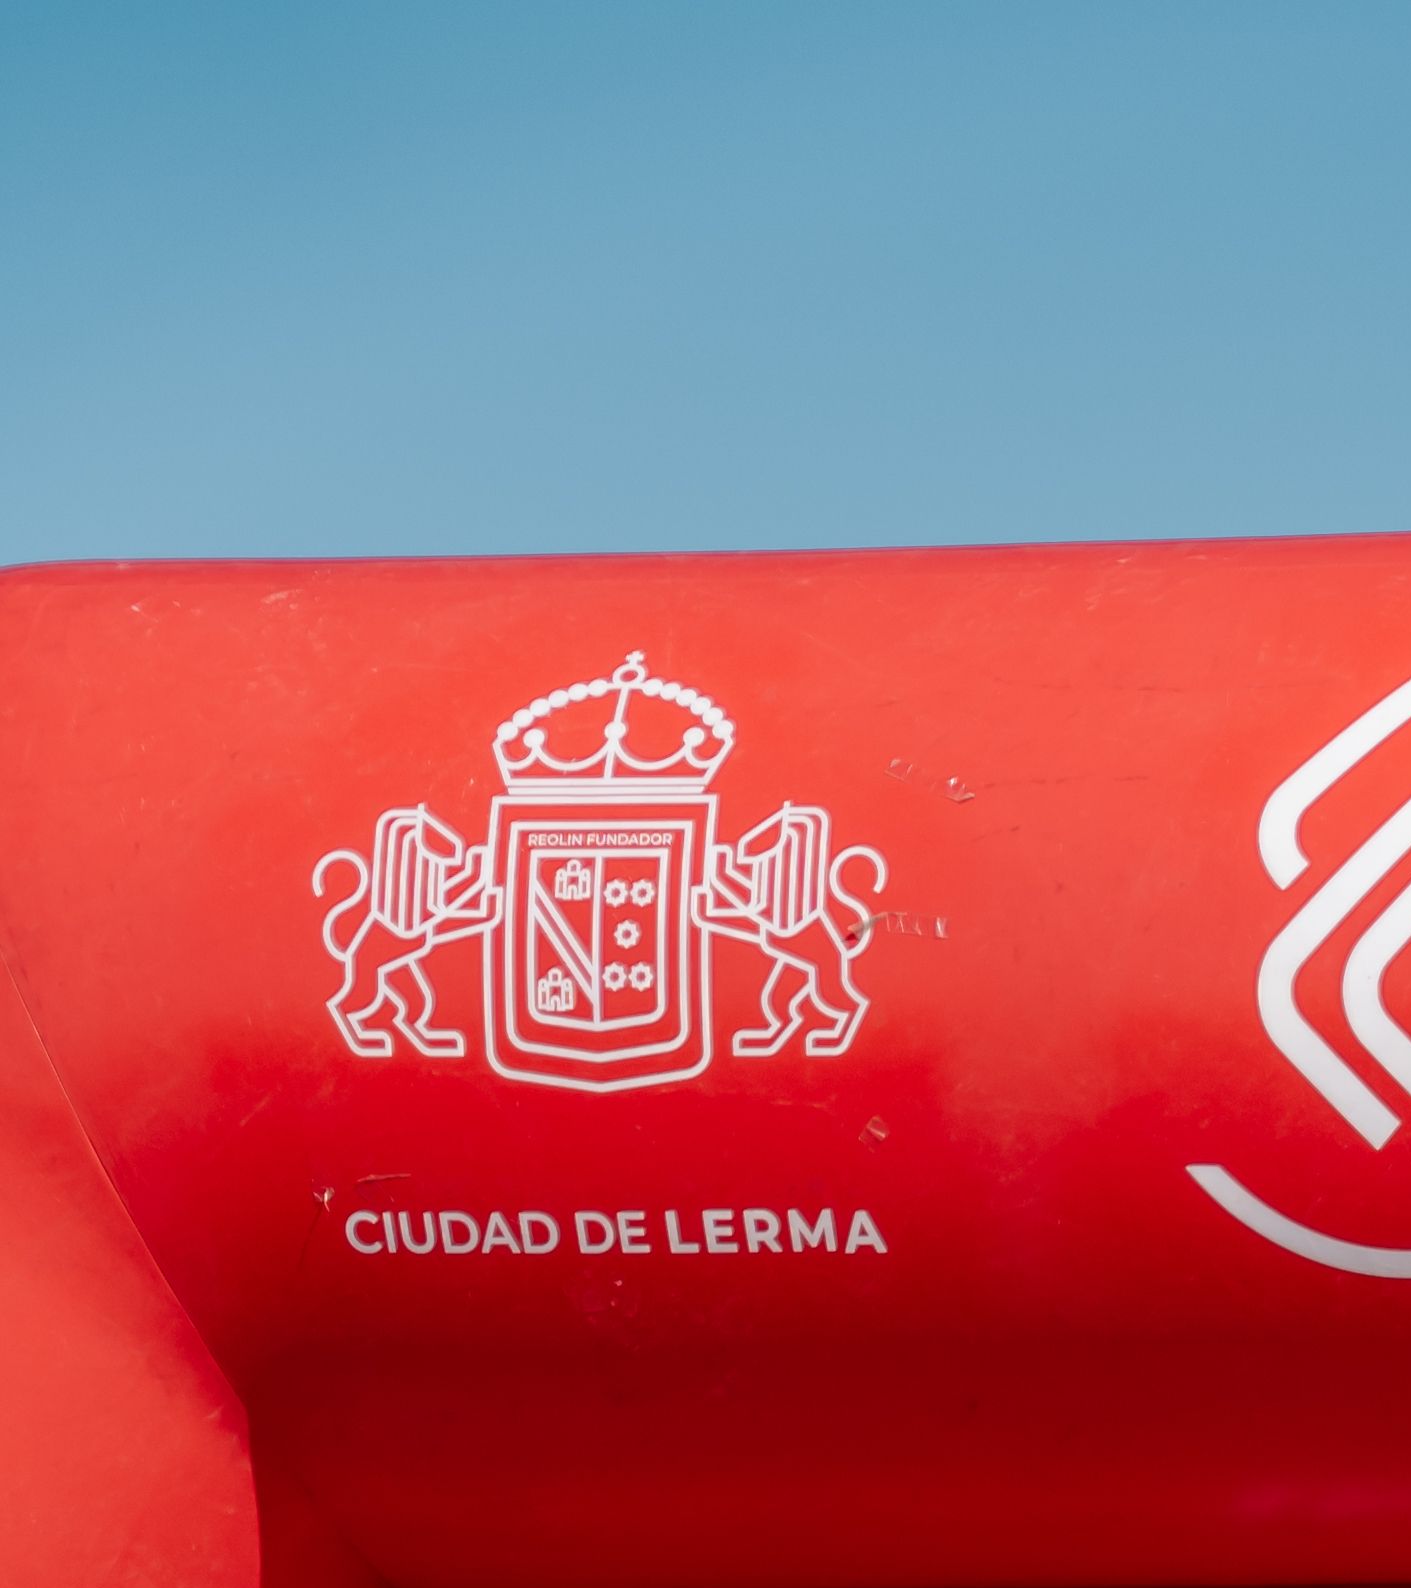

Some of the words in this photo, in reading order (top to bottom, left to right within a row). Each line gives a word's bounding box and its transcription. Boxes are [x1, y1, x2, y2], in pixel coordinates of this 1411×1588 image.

[527, 833, 583, 846] REOLIN
[586, 832, 674, 846] FUNDADOR
[345, 1209, 560, 1255] CIUDAD
[575, 1208, 651, 1255] DE
[666, 1207, 888, 1255] LERMA
